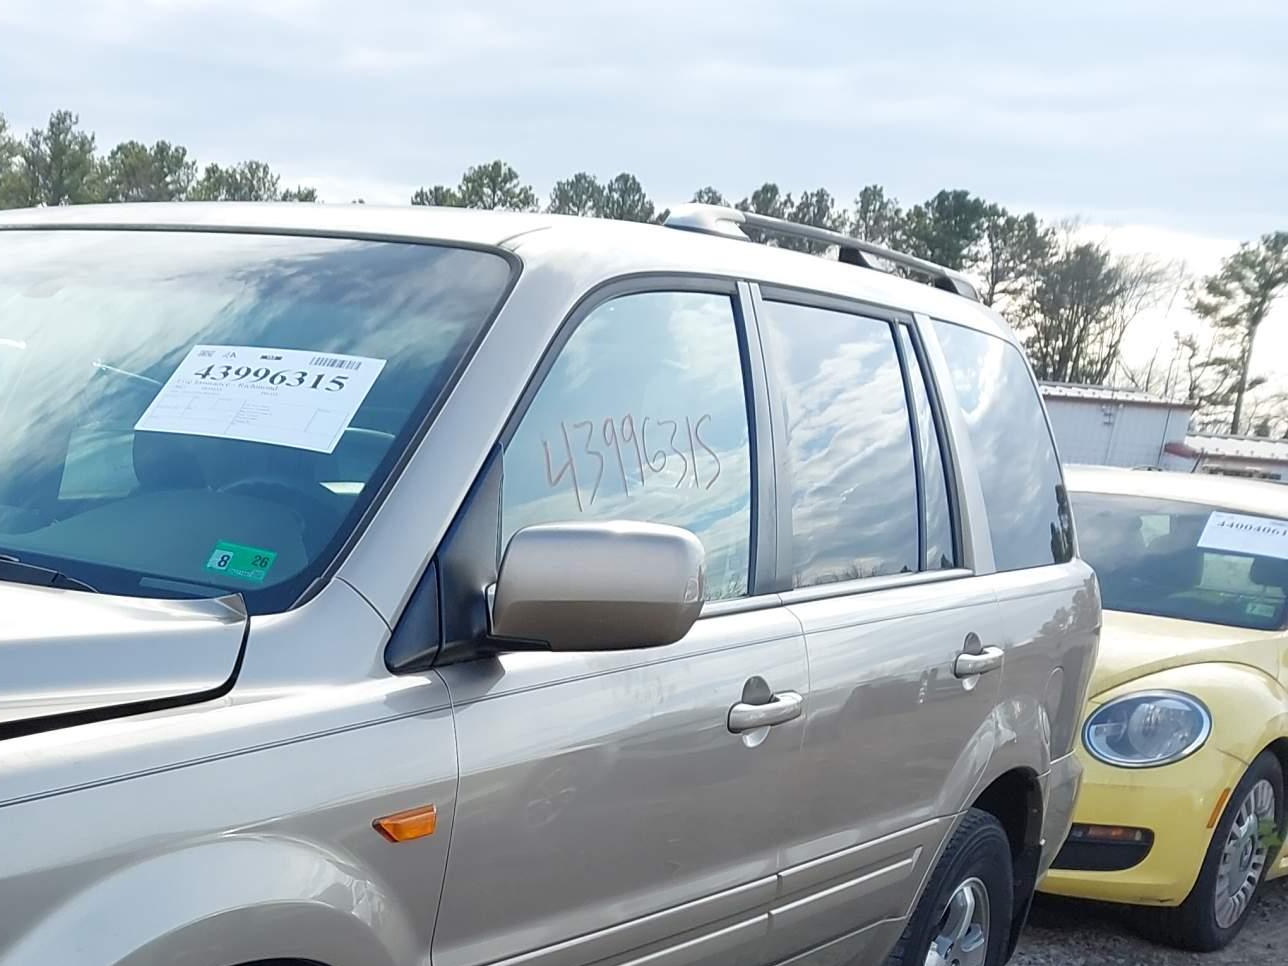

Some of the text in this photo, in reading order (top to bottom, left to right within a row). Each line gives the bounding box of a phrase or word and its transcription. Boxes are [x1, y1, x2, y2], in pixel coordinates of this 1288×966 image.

[194, 364, 350, 392] 43996315
[542, 414, 720, 512] 43996315
[218, 554, 270, 568] 8 26
